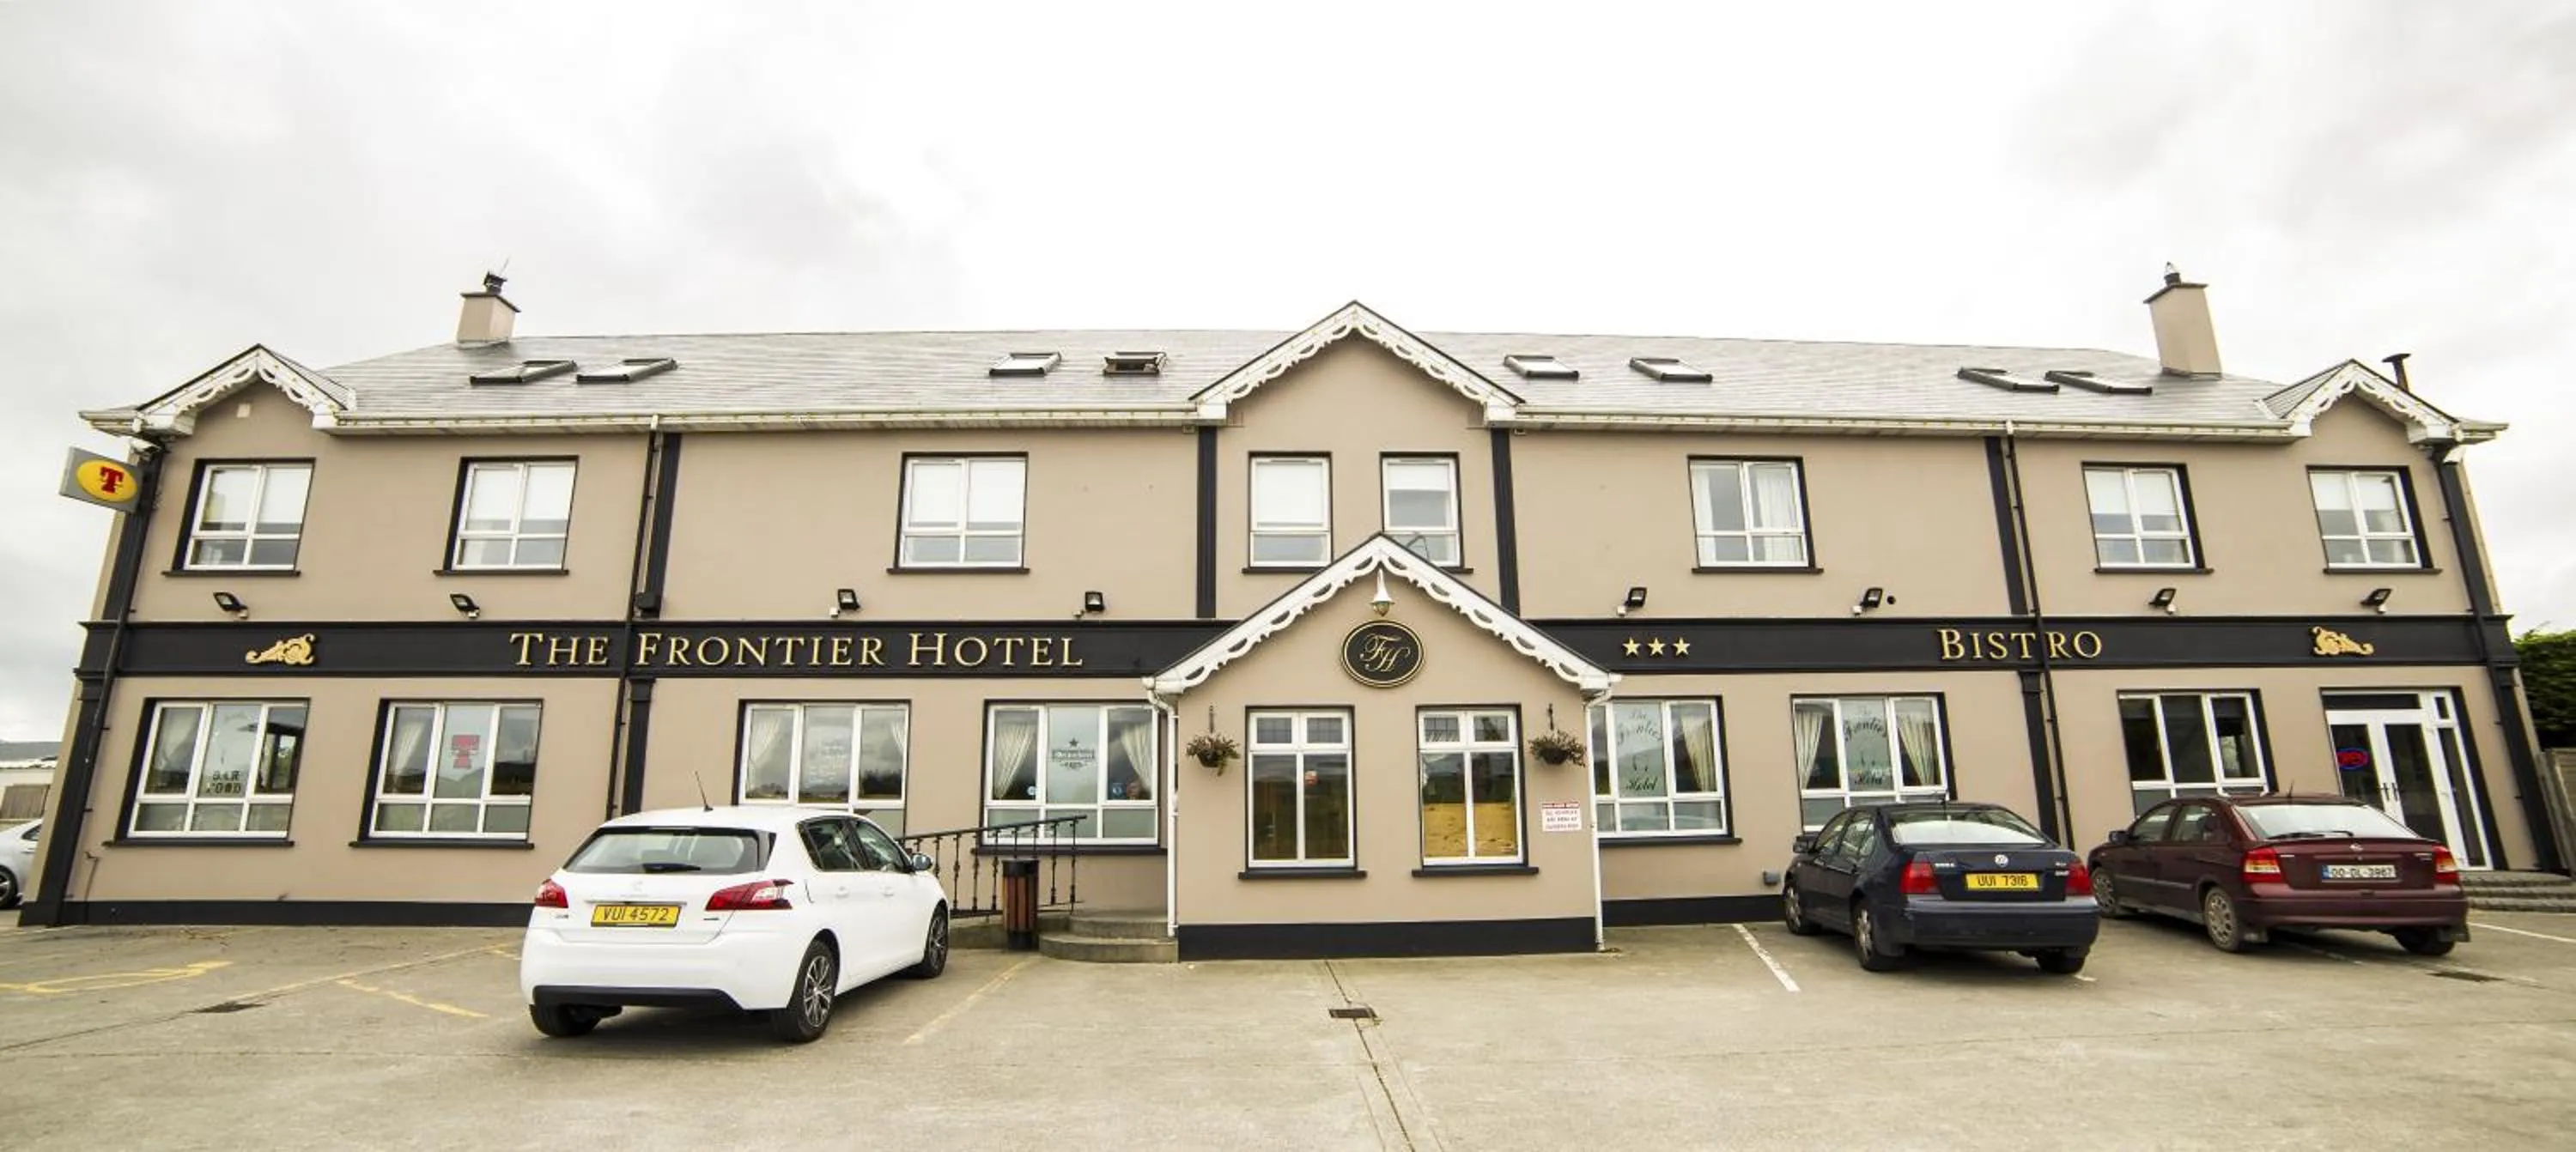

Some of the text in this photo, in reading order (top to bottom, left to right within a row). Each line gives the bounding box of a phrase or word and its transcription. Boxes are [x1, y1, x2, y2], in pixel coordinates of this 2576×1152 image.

[508, 632, 1084, 667] THE FRONTIER HOTEL
[1936, 628, 2103, 660] BISTRO
[629, 906, 669, 921] 4572
